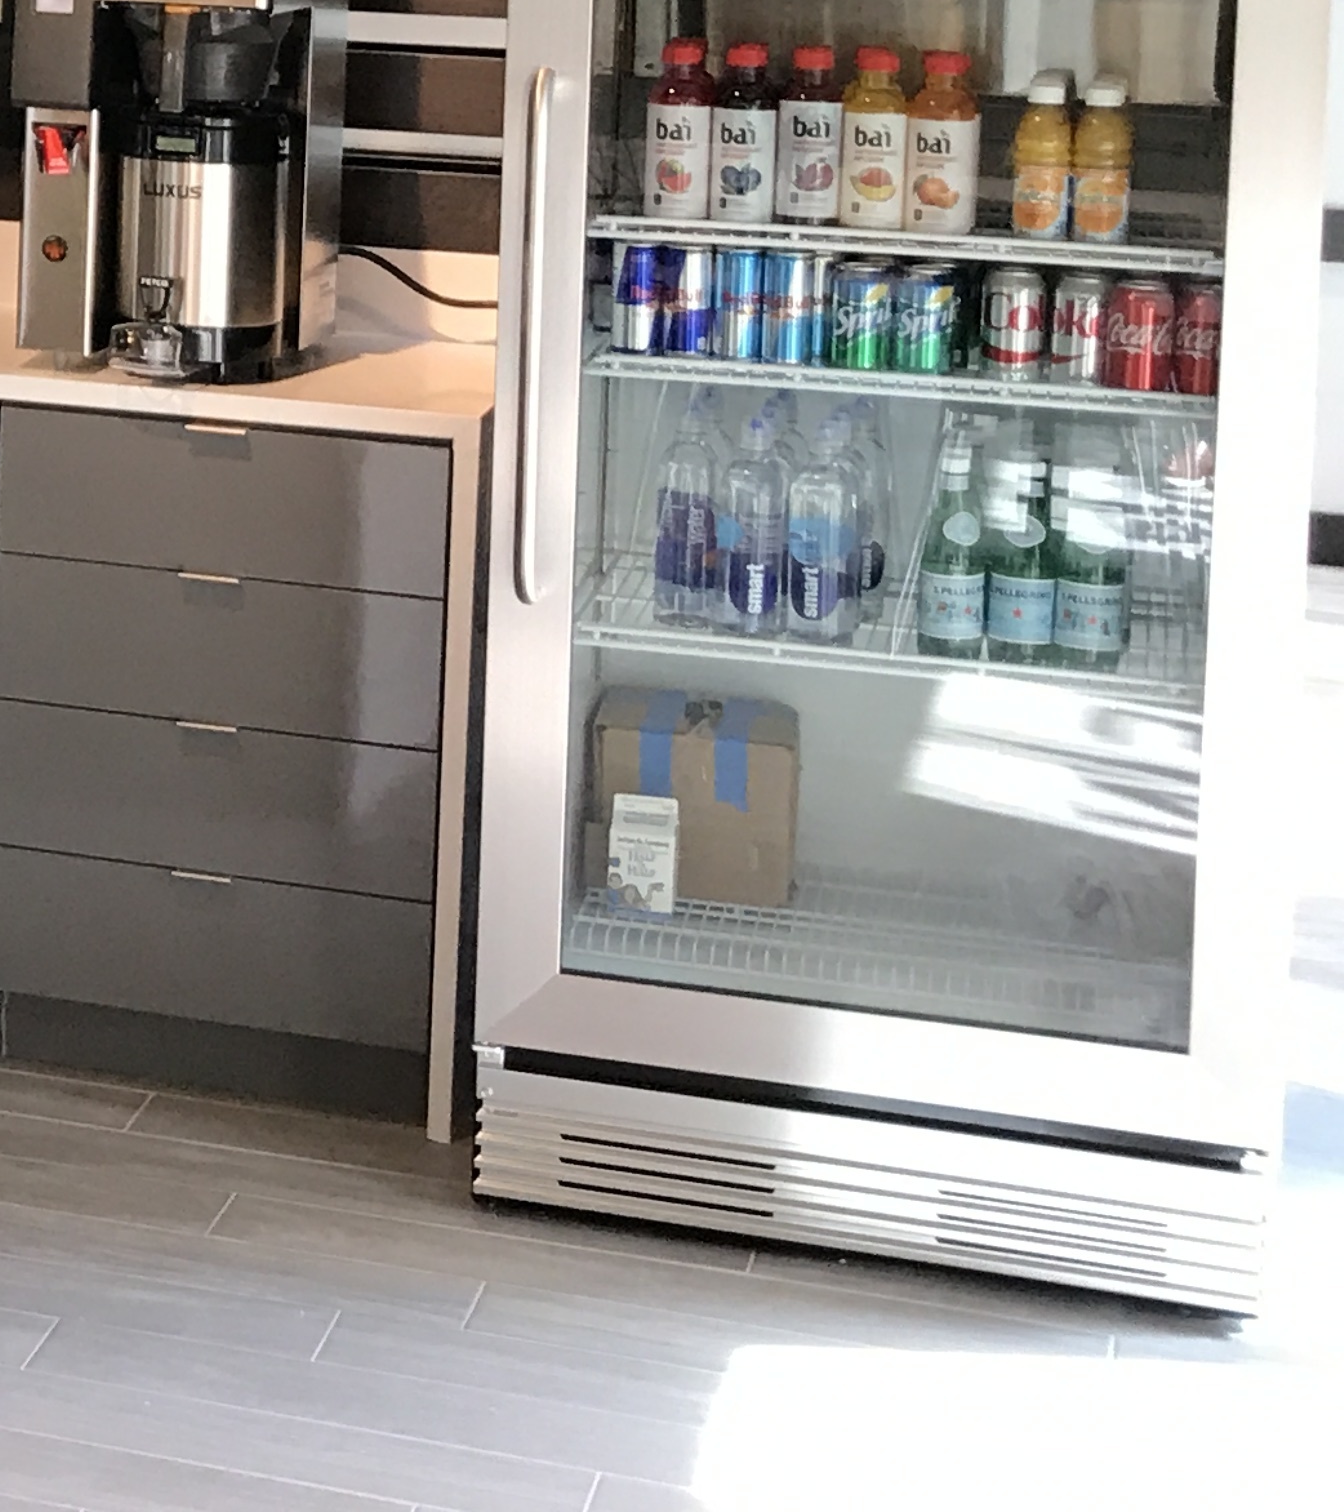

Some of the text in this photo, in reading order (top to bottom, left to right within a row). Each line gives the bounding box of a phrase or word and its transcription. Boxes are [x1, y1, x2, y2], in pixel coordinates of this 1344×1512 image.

[143, 183, 203, 199] LUXUS
[747, 563, 765, 614] smart
[802, 566, 819, 619] smart
